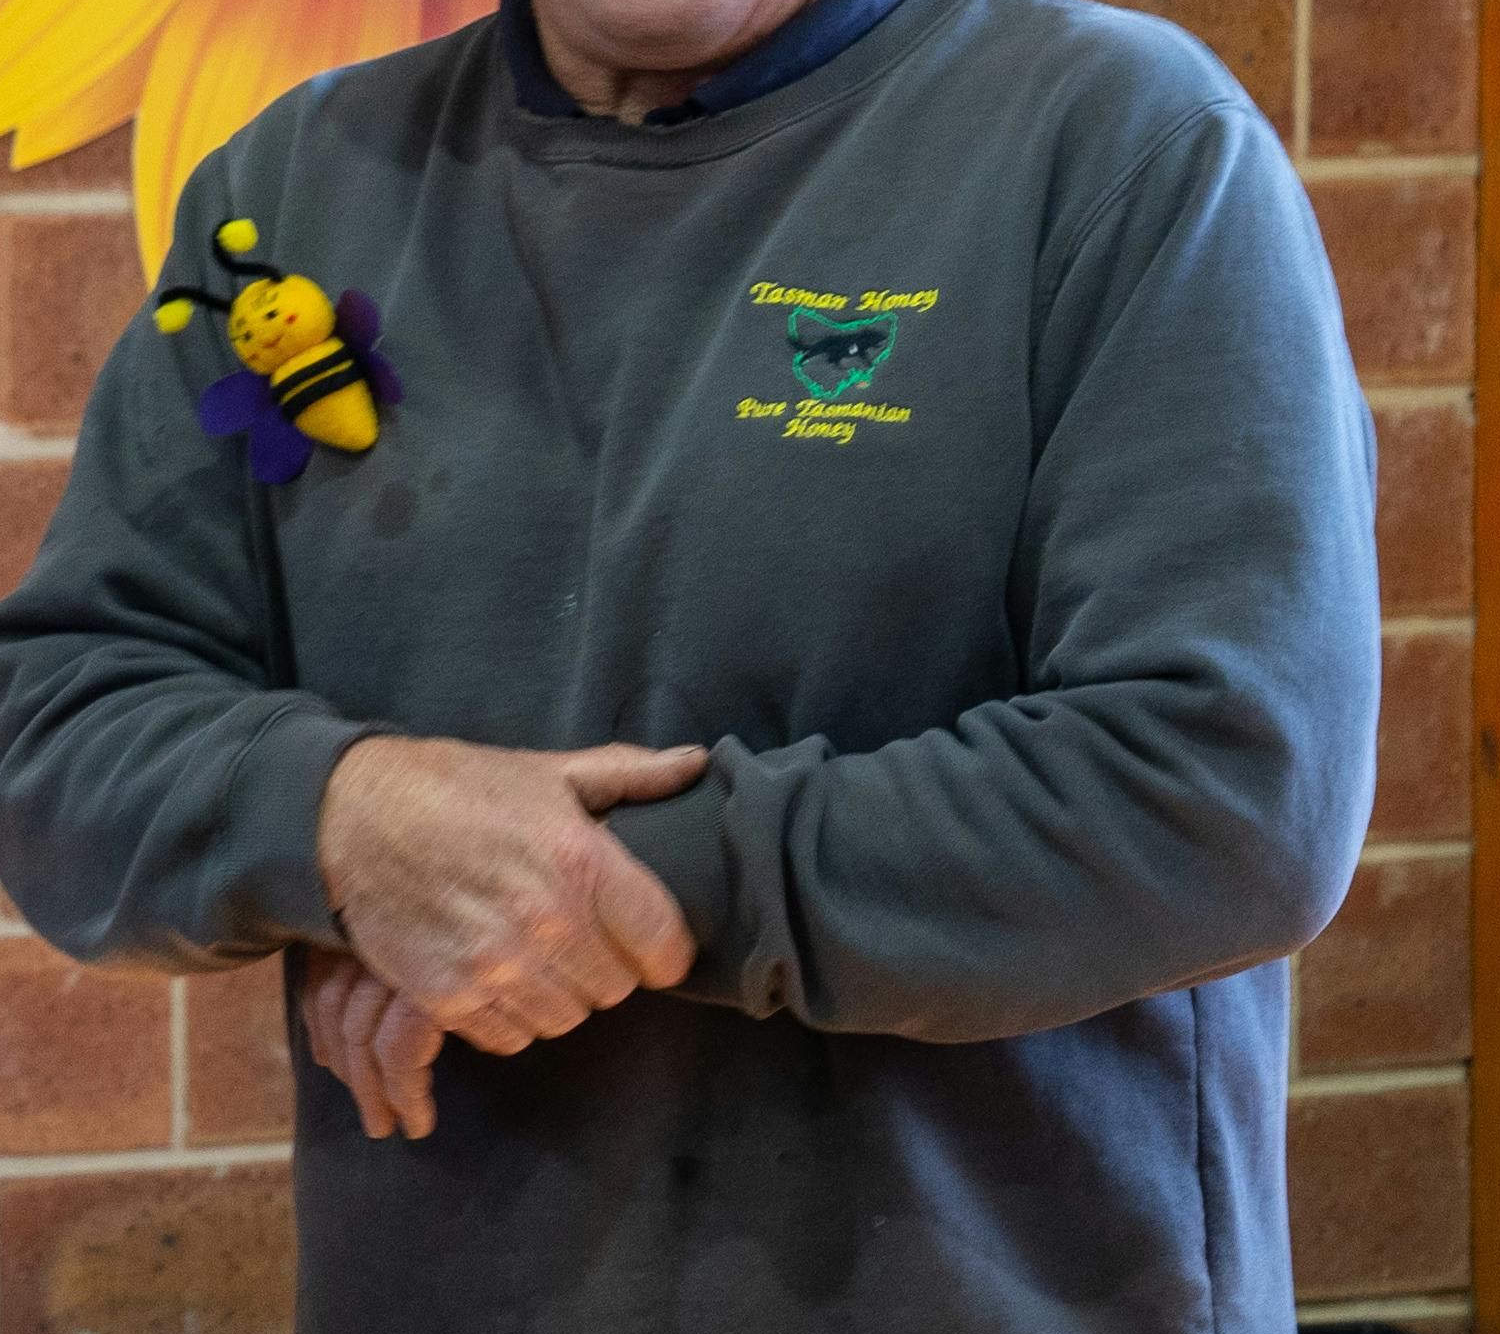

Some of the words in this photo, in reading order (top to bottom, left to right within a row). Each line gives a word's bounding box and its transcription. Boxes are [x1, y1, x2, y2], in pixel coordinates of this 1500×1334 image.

[750, 281, 848, 310] Tasman
[855, 287, 939, 313] Honey
[735, 397, 787, 419] Pure
[795, 399, 912, 423] Tasmanian
[781, 417, 857, 444] Honey
